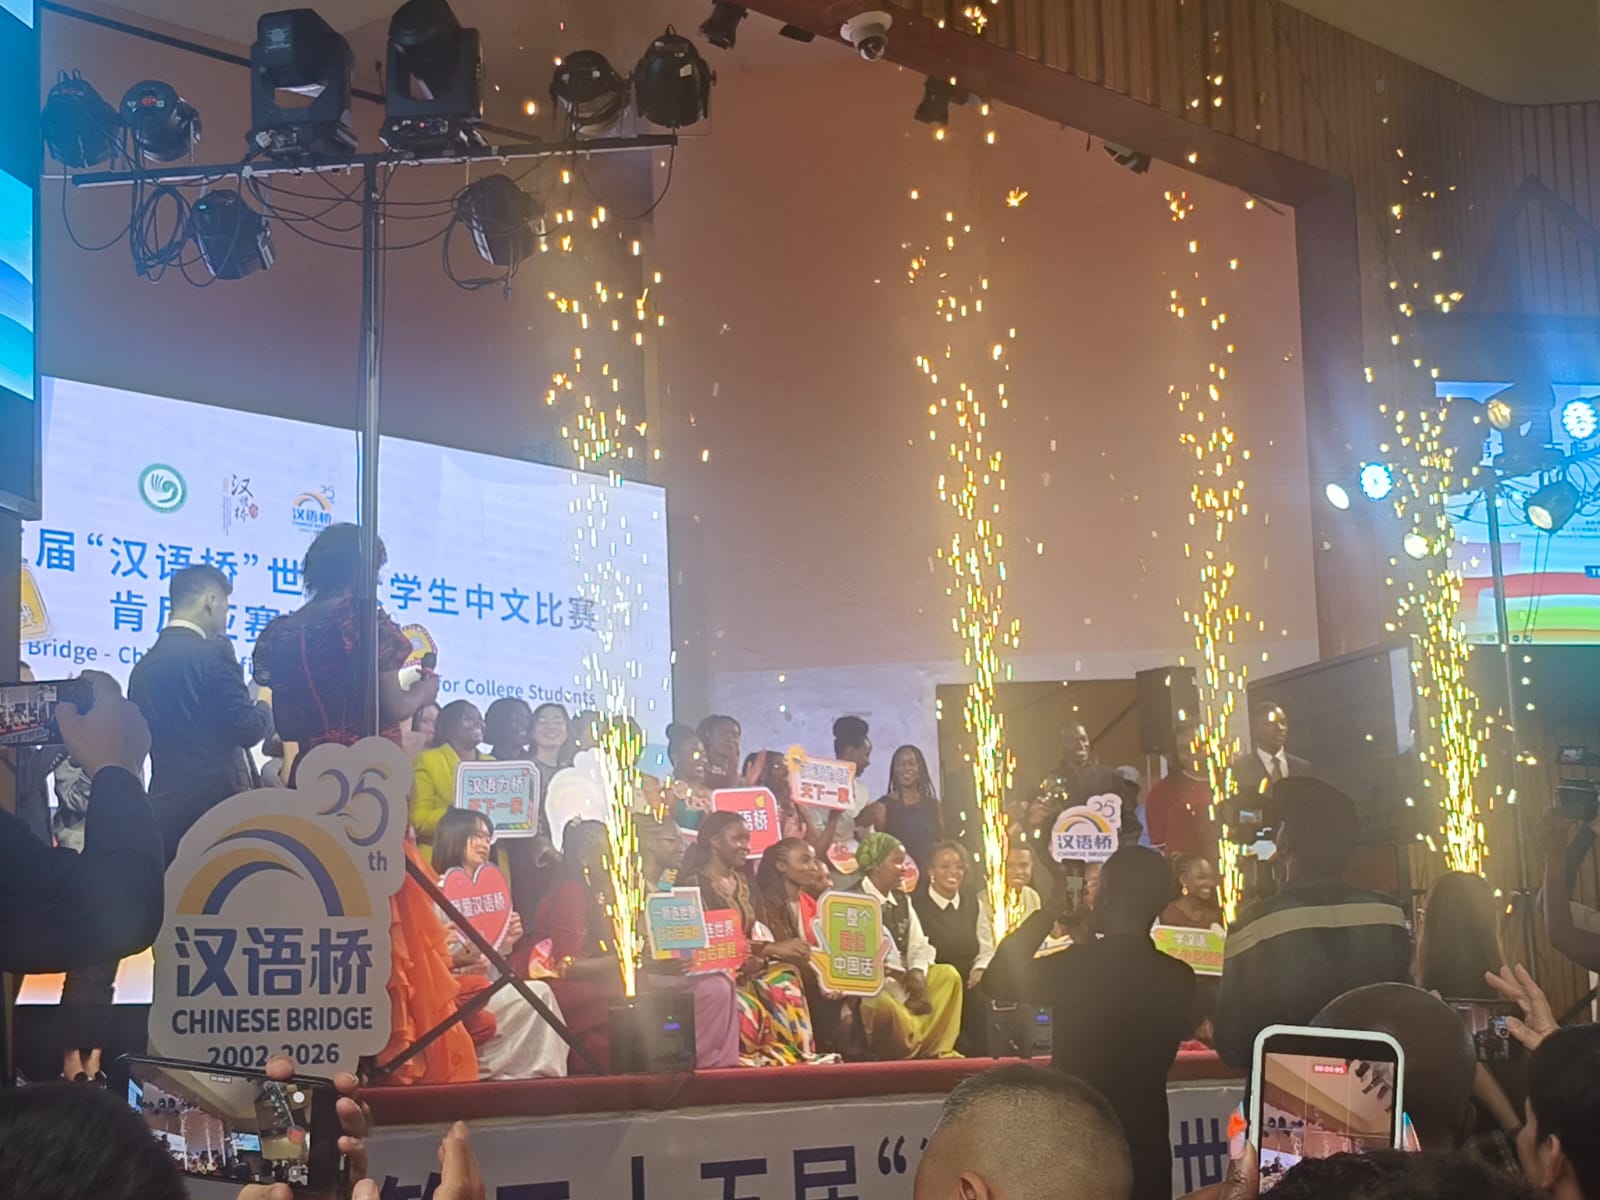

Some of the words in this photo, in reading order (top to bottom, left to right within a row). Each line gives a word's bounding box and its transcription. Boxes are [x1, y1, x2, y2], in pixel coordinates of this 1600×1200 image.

[28, 640, 97, 665] Bridge
[465, 678, 524, 699] College
[317, 767, 390, 848] 25
[367, 850, 389, 872] th
[1057, 834, 1112, 850] 汉语桥
[175, 926, 373, 998] 汉语桥
[172, 1008, 280, 1035] CHINESE
[286, 1006, 373, 1031] BRIDGE
